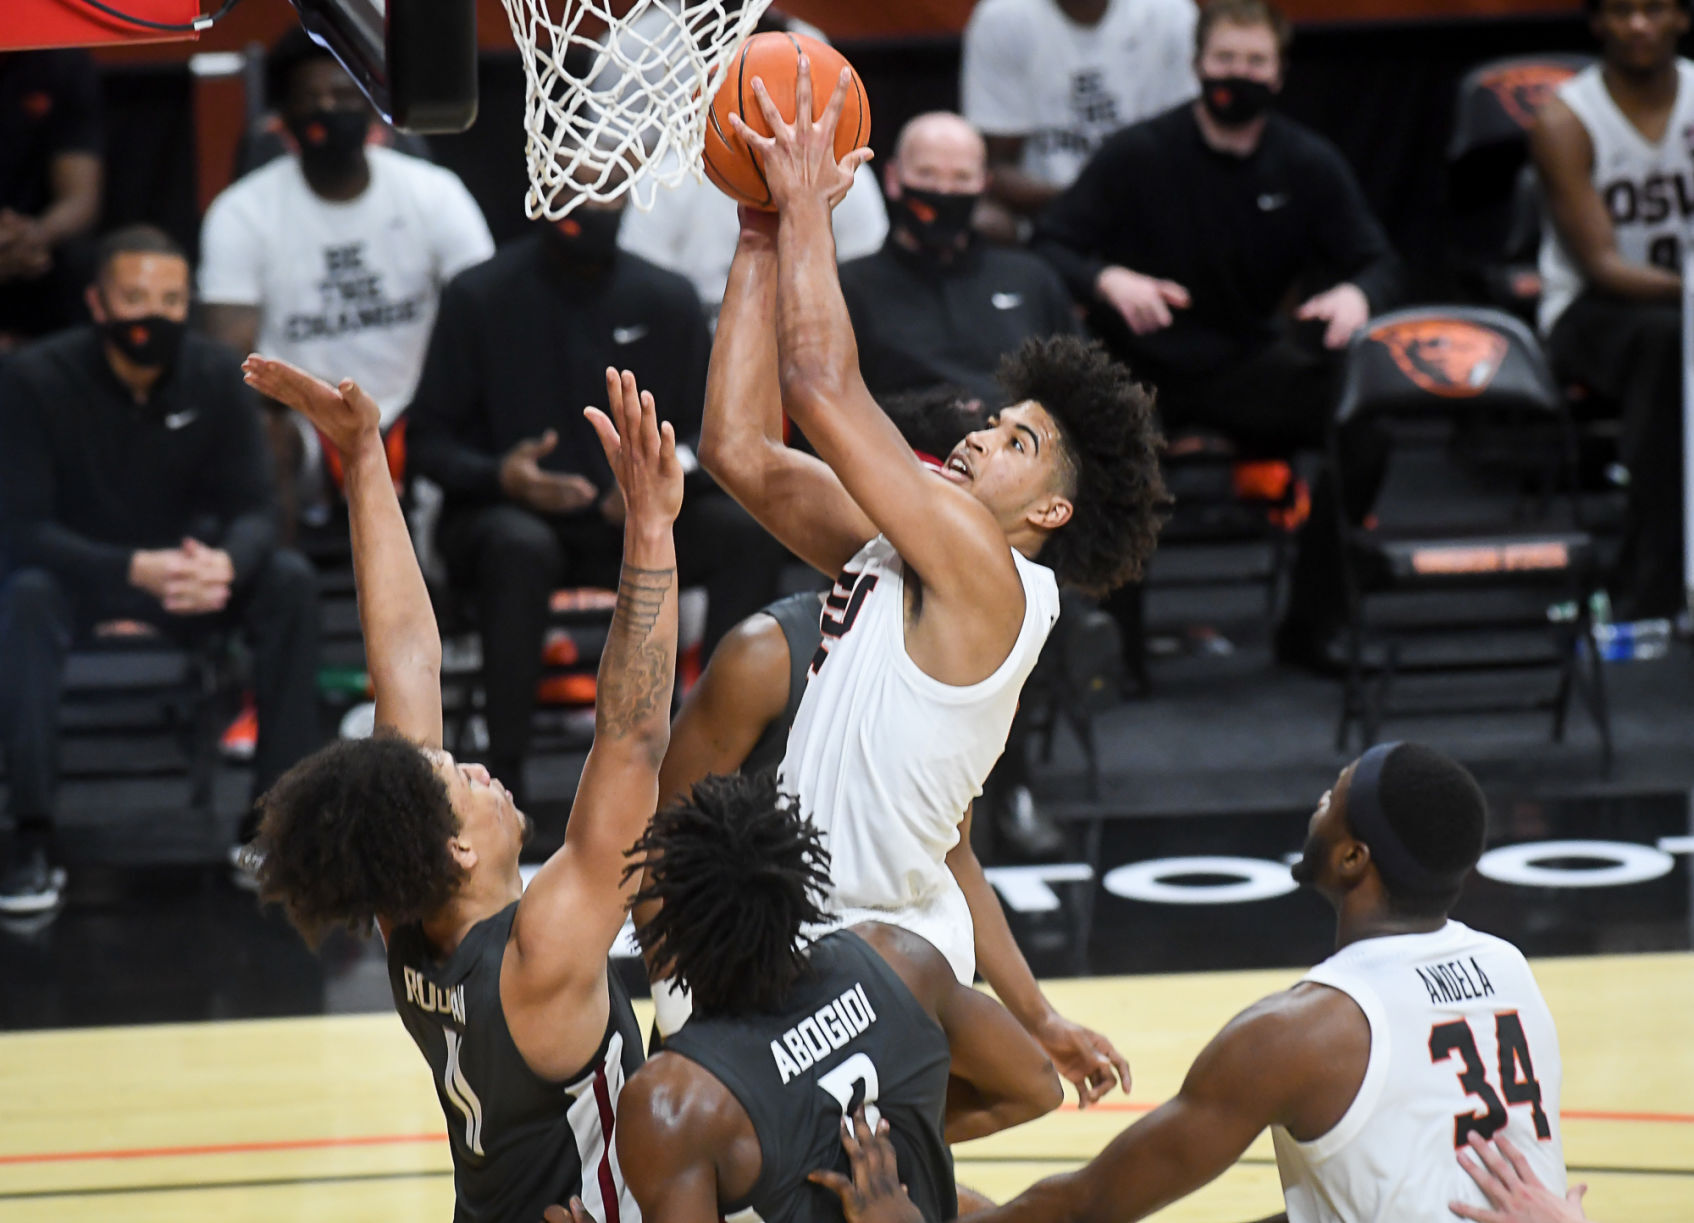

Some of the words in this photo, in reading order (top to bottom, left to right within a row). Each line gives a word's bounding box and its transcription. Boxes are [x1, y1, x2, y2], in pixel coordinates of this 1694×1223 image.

[1415, 956, 1495, 1004] ANDELA
[770, 981, 877, 1085] ABOGIDI
[1428, 1008, 1551, 1150] 34
